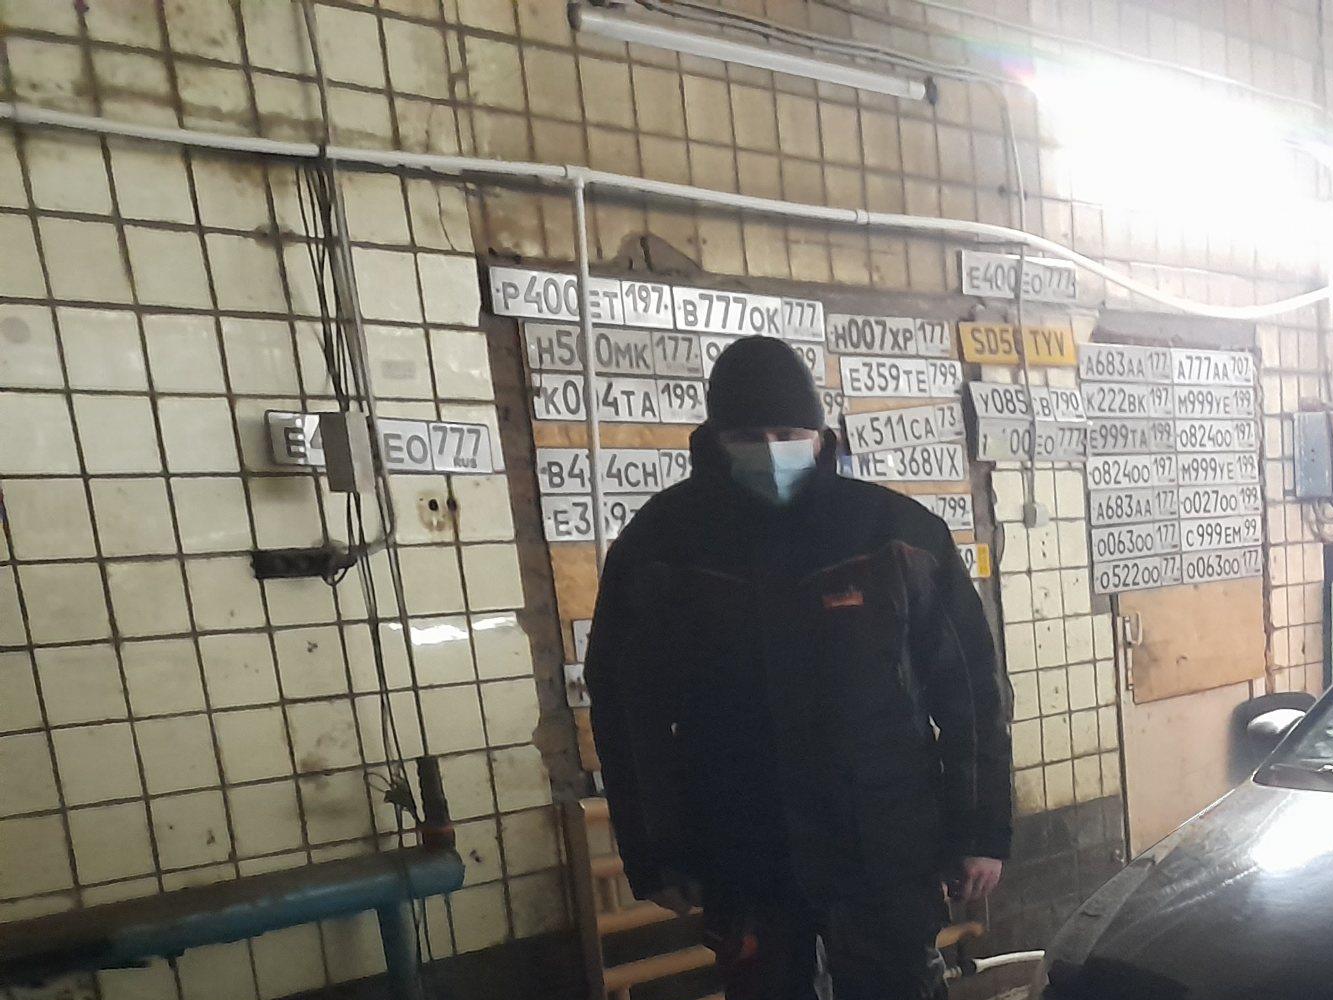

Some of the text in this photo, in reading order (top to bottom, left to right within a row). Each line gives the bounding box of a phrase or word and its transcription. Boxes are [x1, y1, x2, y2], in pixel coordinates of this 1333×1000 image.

[625, 283, 664, 314] 197
[683, 293, 816, 334] В777ОК 777
[537, 330, 650, 370] Н50МК
[655, 335, 693, 363] 177
[834, 318, 945, 351] Н007ХР 177
[971, 327, 1065, 357] SD5 TYV
[849, 362, 957, 393] Е359ТЕ 799
[1085, 351, 1168, 377] А683АА 177
[1177, 355, 1230, 381] А777АА
[541, 380, 698, 418] К04ТА 199
[1085, 387, 1169, 413] К222ВК 197
[432, 425, 480, 456] 777
[856, 414, 936, 448] К511СА
[547, 452, 691, 488] В44СН 79
[1153, 456, 1173, 476] 197
[938, 497, 966, 518] 799
[1097, 490, 1175, 521] А683АА 177
[1157, 523, 1176, 543] 177
[1186, 522, 1242, 547] С999ЕМ
[1163, 556, 1176, 577] 77
